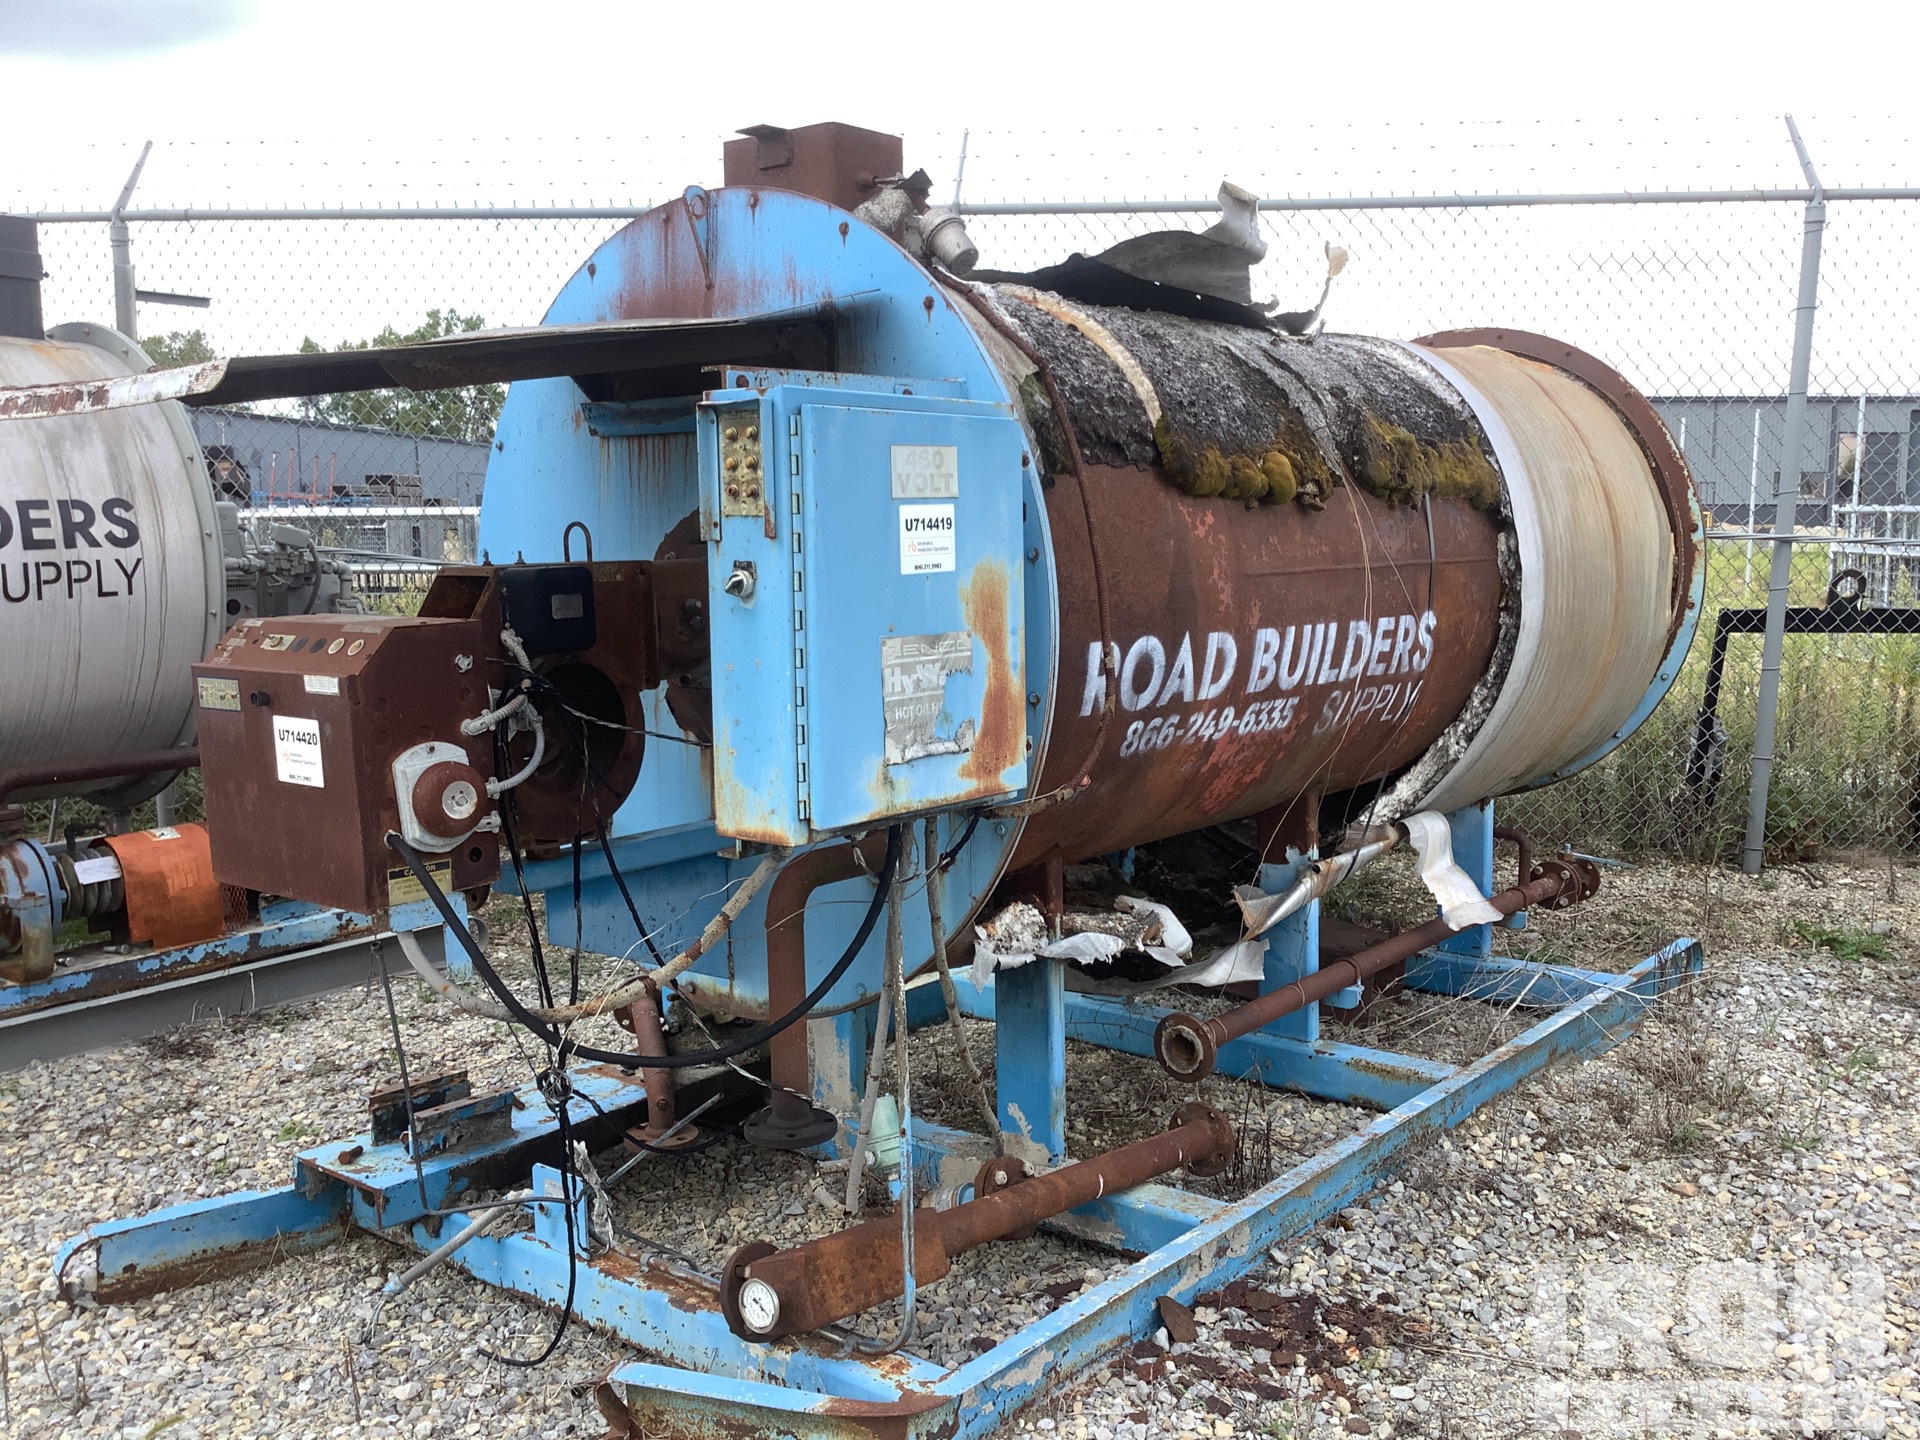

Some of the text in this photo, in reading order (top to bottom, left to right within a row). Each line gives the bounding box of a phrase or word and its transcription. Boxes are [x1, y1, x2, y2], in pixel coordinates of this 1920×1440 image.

[896, 472, 954, 494] VOLT
[905, 517, 952, 531] U714419
[1245, 610, 1437, 695] BUILDERS
[1120, 680, 1423, 757] 866-249-6335 SUPPLY
[279, 729, 318, 746] U714420
